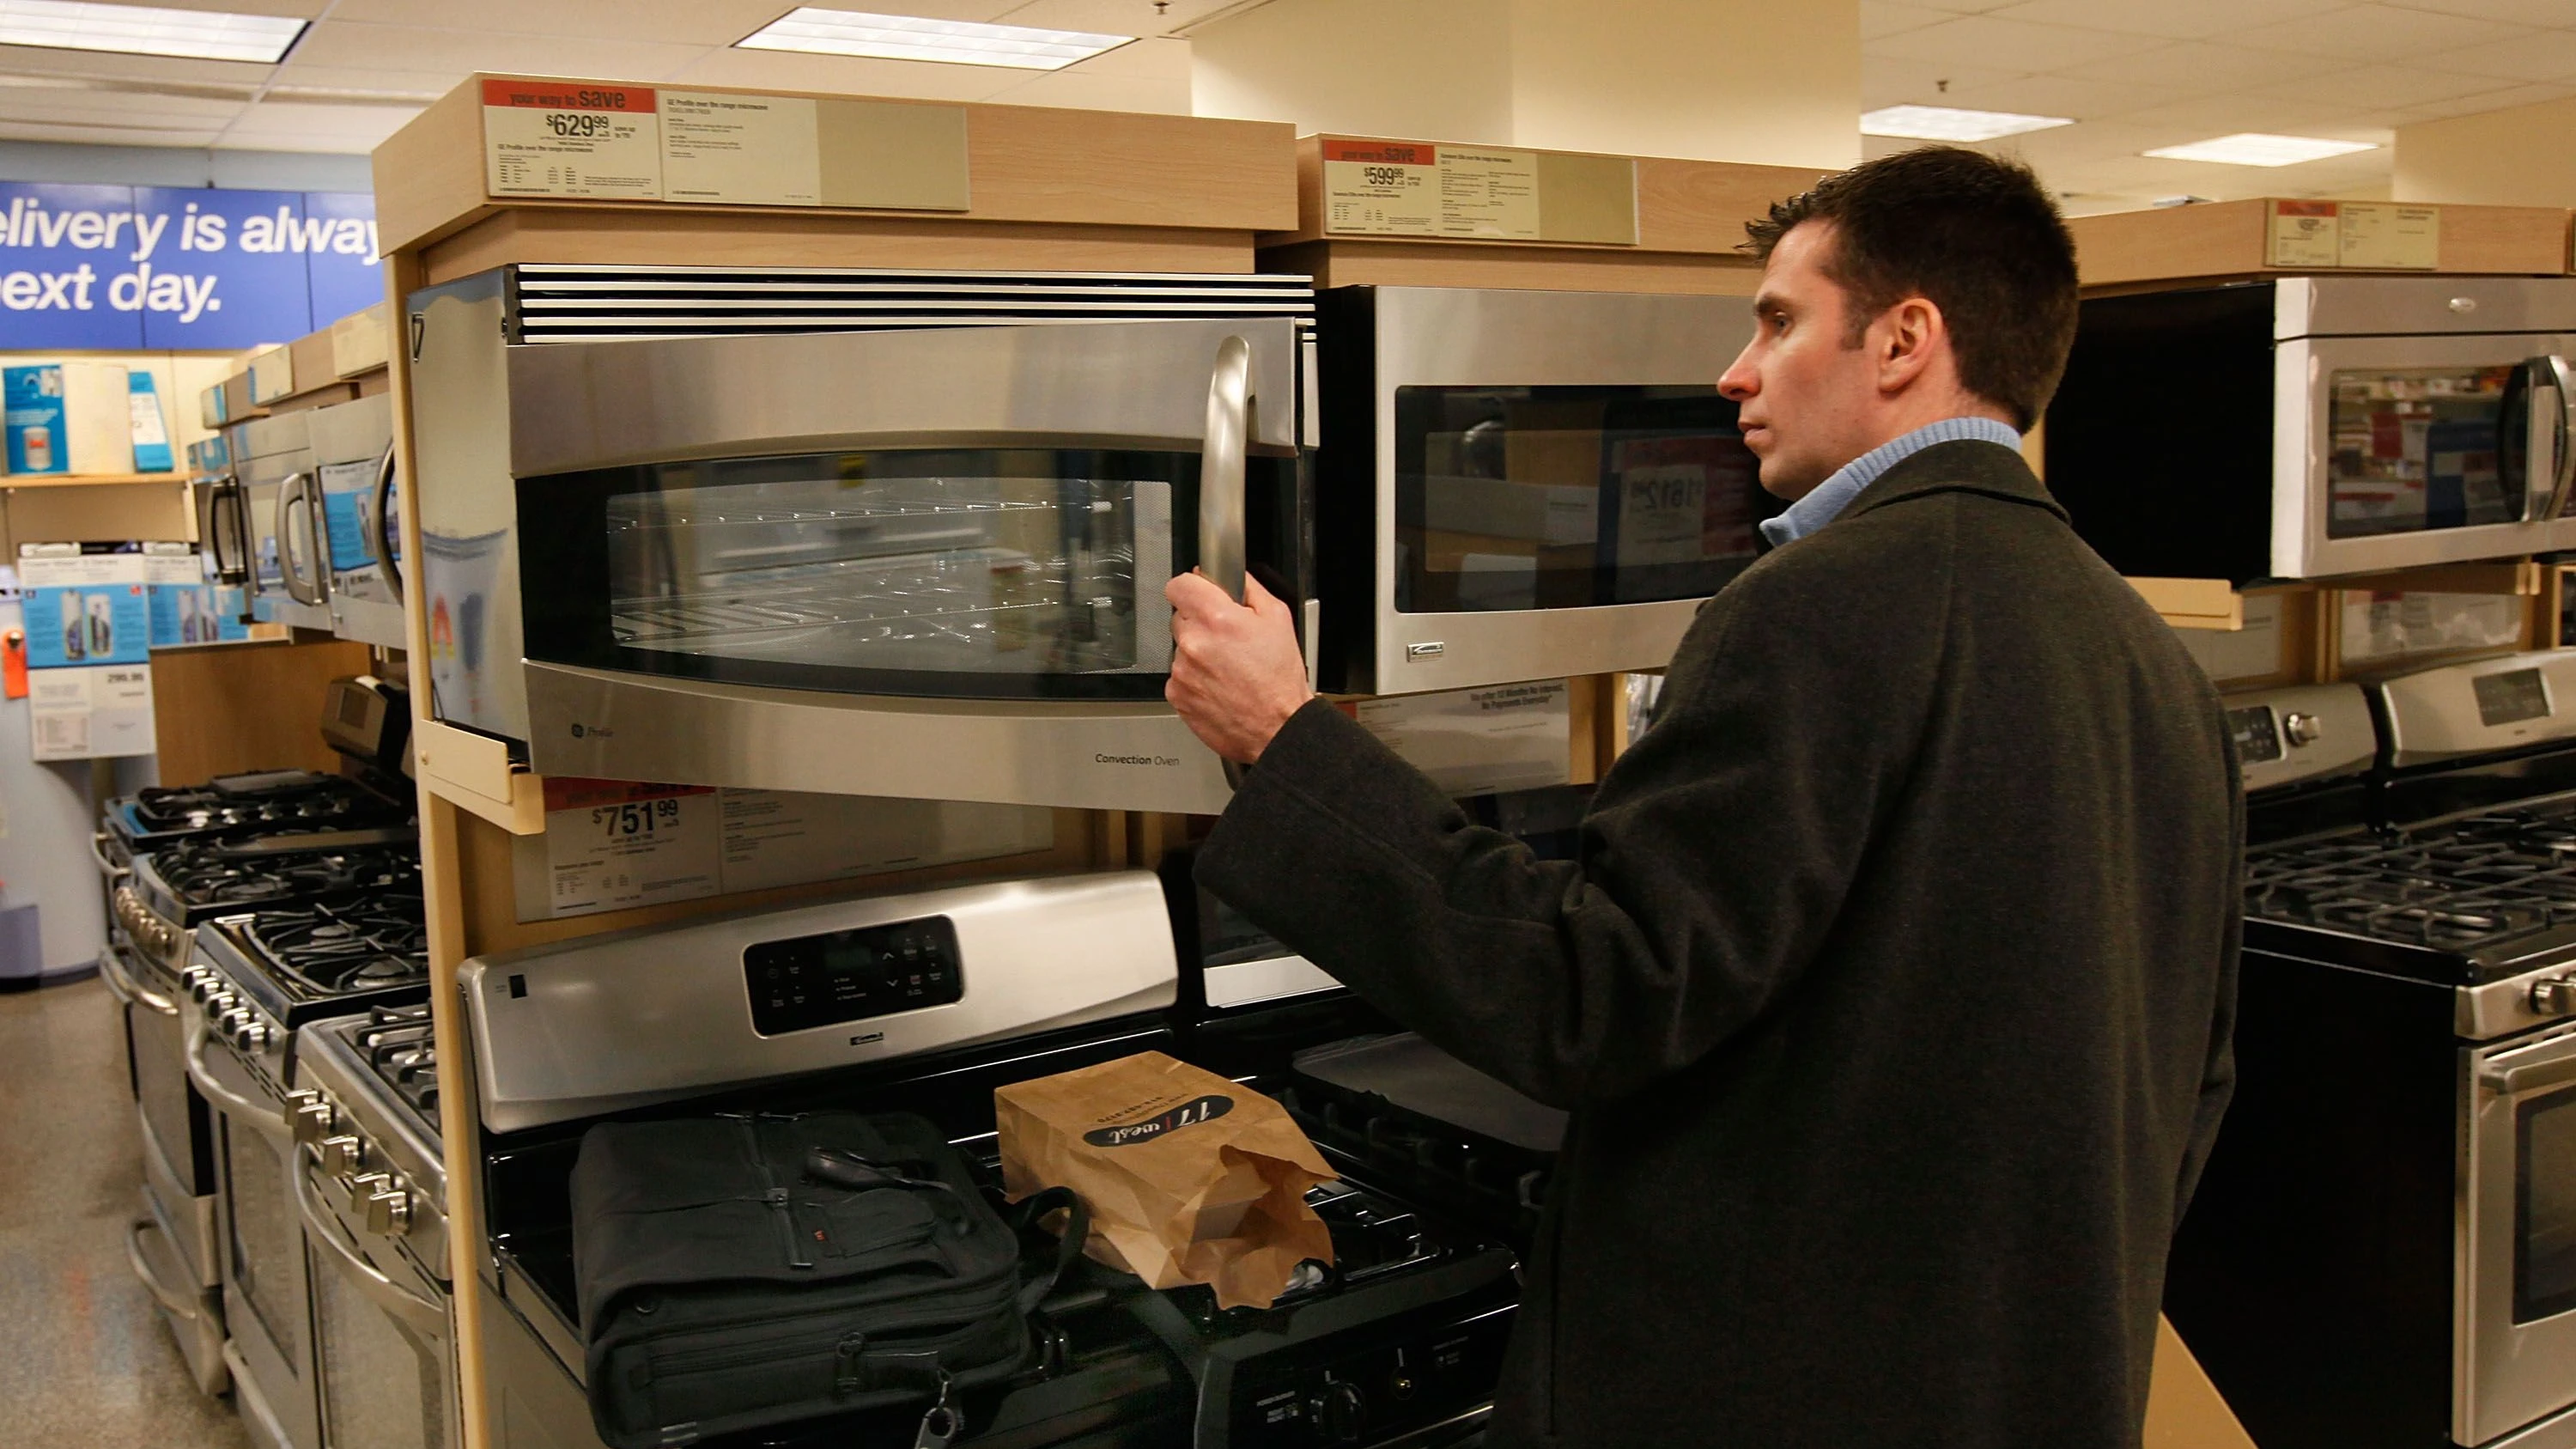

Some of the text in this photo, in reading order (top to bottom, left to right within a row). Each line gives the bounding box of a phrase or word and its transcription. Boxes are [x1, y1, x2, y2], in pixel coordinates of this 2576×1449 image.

[579, 90, 626, 108] save
[1386, 147, 1414, 162] save
[0, 198, 169, 262] livery
[180, 203, 227, 253] is
[0, 263, 222, 324] ext day.
[1095, 753, 1180, 766] Convection Oven
[1177, 1102, 1212, 1127] 17
[1108, 1122, 1161, 1144] west
